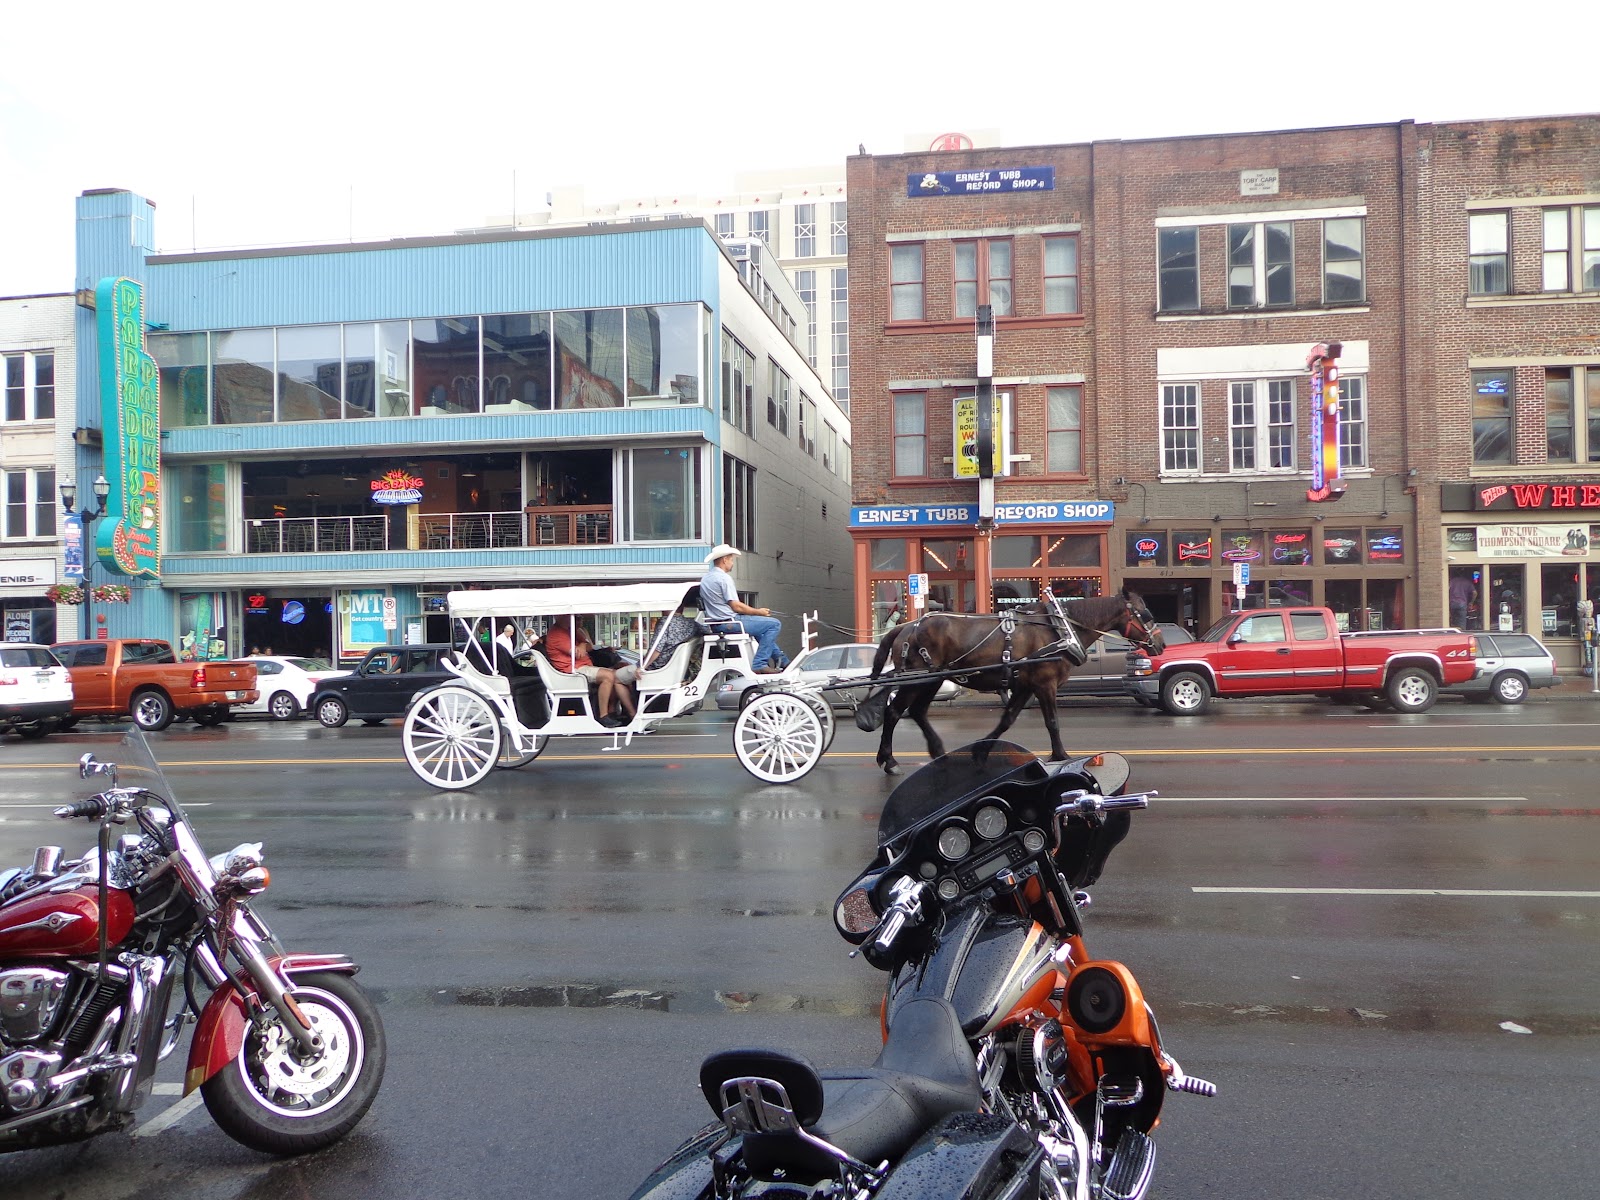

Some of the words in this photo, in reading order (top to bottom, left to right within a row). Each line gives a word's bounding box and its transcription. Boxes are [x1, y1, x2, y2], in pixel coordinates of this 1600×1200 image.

[955, 172, 990, 182] ERNEST
[999, 170, 1021, 180] TUBB
[966, 181, 1001, 191] RECORD
[1012, 179, 1037, 188] SHOP
[121, 284, 142, 527] PARADISE
[140, 359, 156, 468] PARK
[371, 480, 391, 490] BIG
[391, 477, 424, 489] BANG
[1481, 485, 1507, 507] THE
[858, 509, 920, 523] ERNEST
[925, 507, 969, 521] TUBB
[994, 505, 1058, 520] RECORD
[1063, 504, 1109, 518] SHOP
[1501, 527, 1514, 536] WE
[1516, 526, 1538, 536] LOVE
[1479, 537, 1526, 547] THOMPSON
[1528, 536, 1561, 547] SQUARE
[337, 594, 383, 614] CMT
[684, 685, 699, 697] 22
